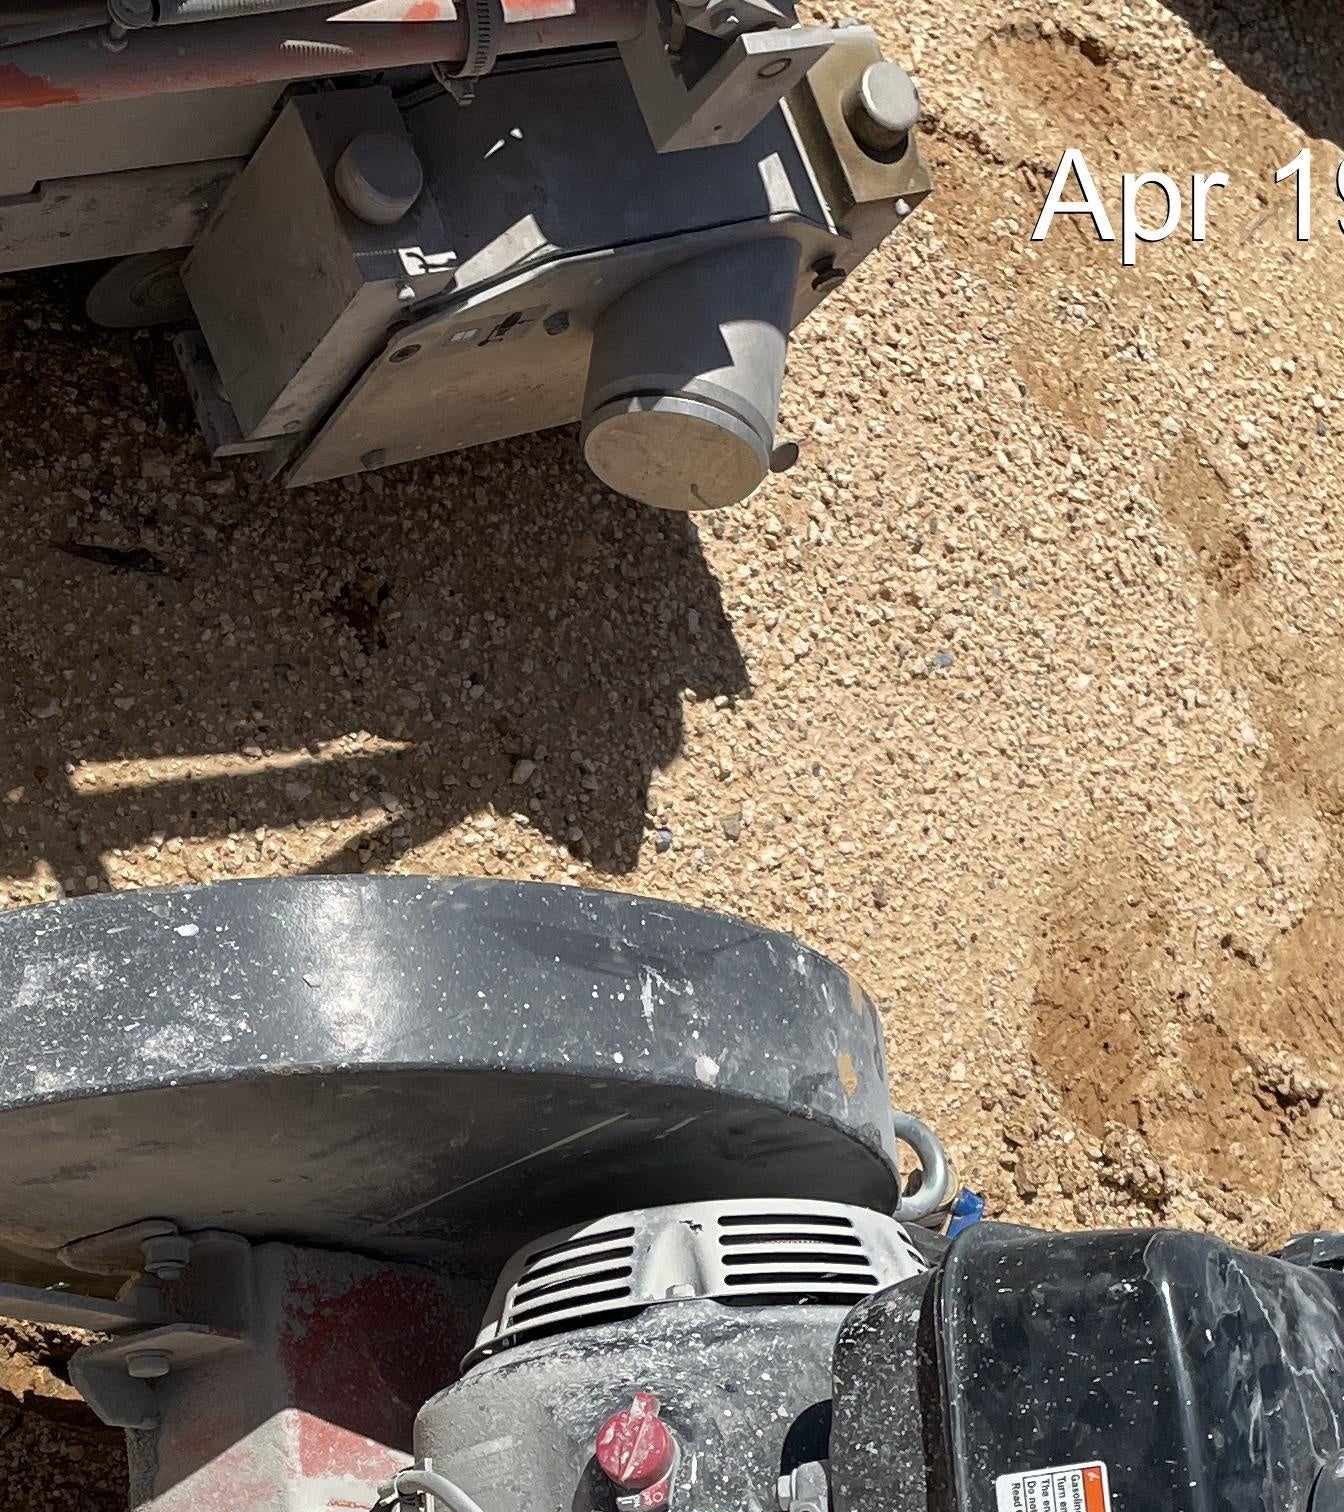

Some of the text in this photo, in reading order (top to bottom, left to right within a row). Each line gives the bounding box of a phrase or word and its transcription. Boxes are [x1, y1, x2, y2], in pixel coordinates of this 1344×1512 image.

[1011, 1482, 1022, 1507] Read
[1026, 1480, 1037, 1494] Do
[1040, 1478, 1051, 1496] The
[1056, 1476, 1068, 1498] Turn
[1028, 1496, 1037, 1512] not
